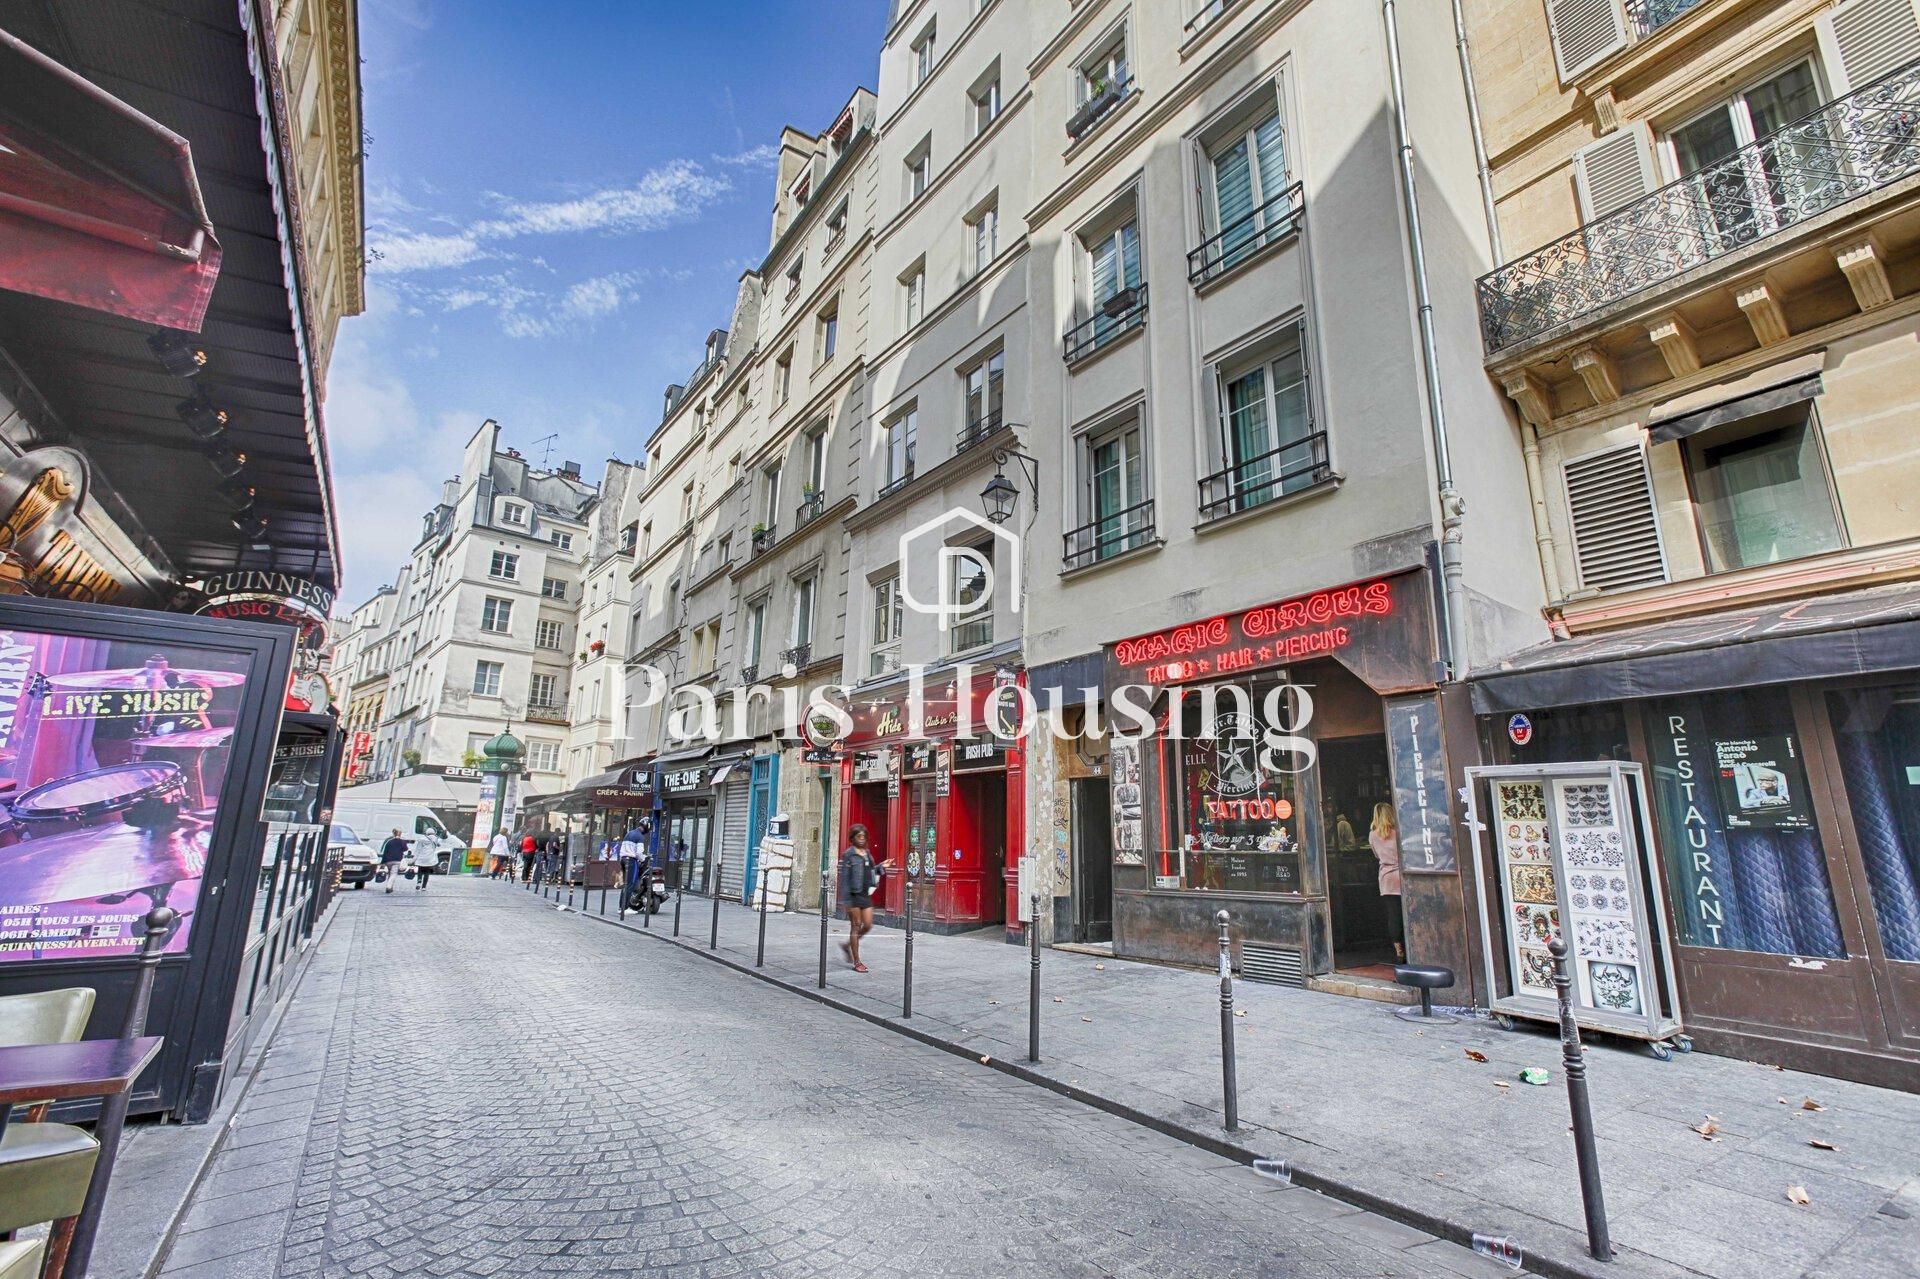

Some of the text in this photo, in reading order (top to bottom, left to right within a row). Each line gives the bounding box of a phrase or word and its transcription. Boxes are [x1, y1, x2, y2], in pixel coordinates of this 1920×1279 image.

[204, 570, 331, 612] GUINNESS
[1115, 583, 1391, 666] MAGIC CIRCUS
[1216, 647, 1254, 672] HAIR
[1276, 626, 1348, 658] PIERCING
[43, 691, 209, 716] LIVE MUSIC
[876, 711, 902, 736] Hide
[981, 743, 994, 758] PUB
[1716, 743, 1759, 752] Antonio
[1185, 753, 1207, 766] ELLE
[596, 788, 619, 796] CRÊPE
[1410, 714, 1434, 865] PIERCING
[1207, 798, 1275, 820] TATTOO
[1246, 834, 1255, 846] 3
[1668, 716, 1723, 945] RESTAURANT
[4, 914, 139, 926] 05H TOUS LES JOURS
[31, 928, 82, 938] SAMEDI
